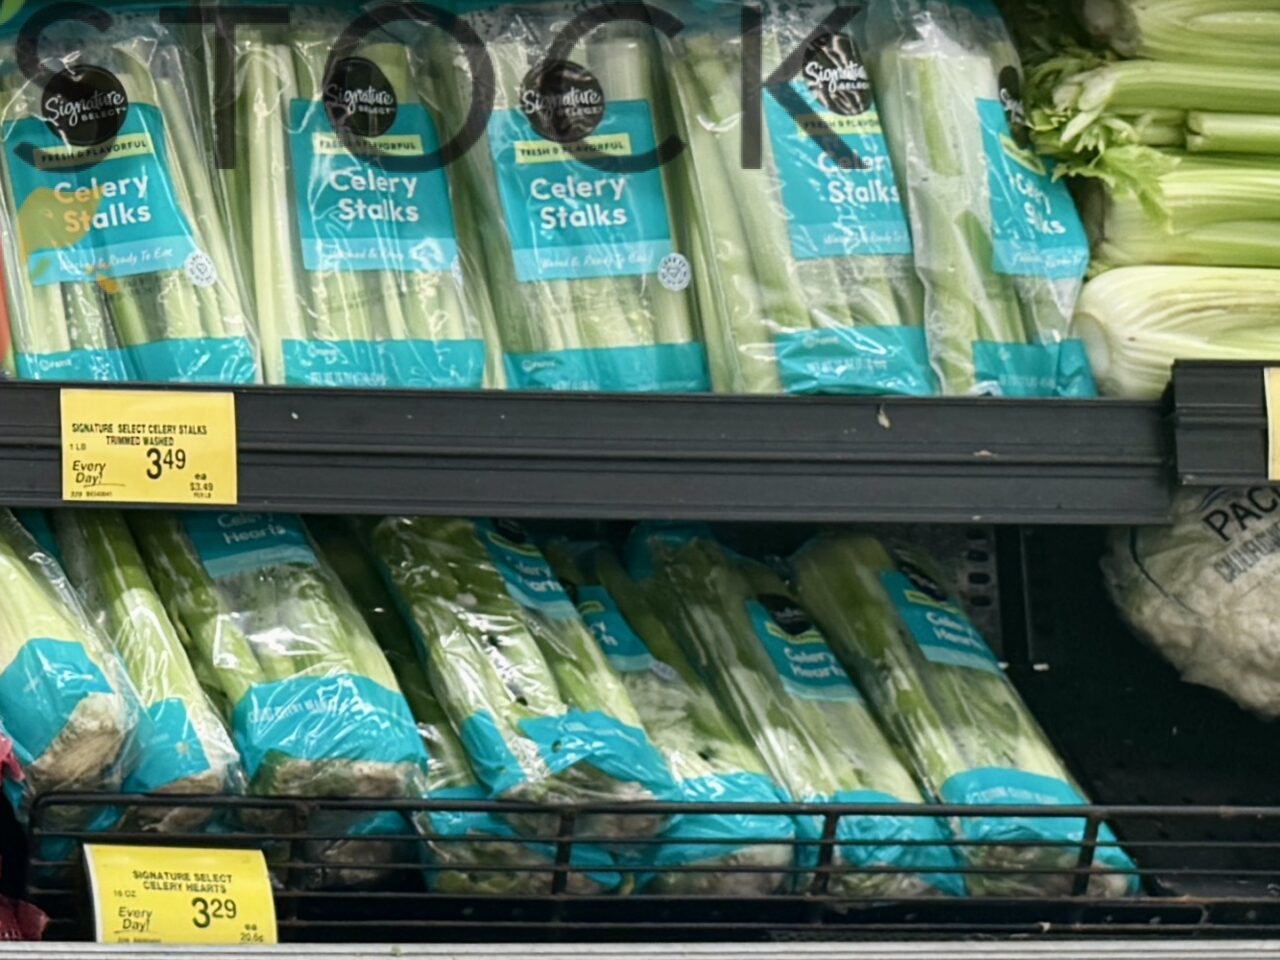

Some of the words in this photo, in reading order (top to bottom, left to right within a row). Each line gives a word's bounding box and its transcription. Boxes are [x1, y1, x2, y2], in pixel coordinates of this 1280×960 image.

[45, 90, 125, 126] Signature
[326, 83, 394, 115] Signature
[86, 140, 147, 157] FLAVORFUL
[53, 175, 149, 204] Celery
[329, 168, 417, 198] Celery
[530, 175, 626, 201] Celery
[829, 180, 900, 204] Stalks
[63, 202, 152, 233] Stalks
[338, 197, 420, 222] Stalks
[540, 204, 628, 230] Stalks
[72, 423, 113, 433] SIGNATURE
[118, 424, 145, 434] SELECT
[148, 425, 177, 434] CELERY
[179, 425, 207, 435] STALKS
[106, 436, 141, 446] TRIMMED
[143, 436, 174, 446] WASHED
[72, 460, 106, 473] Every
[75, 472, 103, 486] Day!
[190, 483, 214, 492] $3.49
[1202, 486, 1280, 542] PAC
[222, 524, 287, 545] Hearts
[132, 870, 191, 882] SIGNATURE
[193, 873, 232, 884] SELECT
[143, 881, 183, 892] CELERY
[186, 883, 227, 894] HEARTS
[118, 907, 152, 920] Every
[122, 918, 151, 932] Day!
[245, 923, 257, 931] ea
